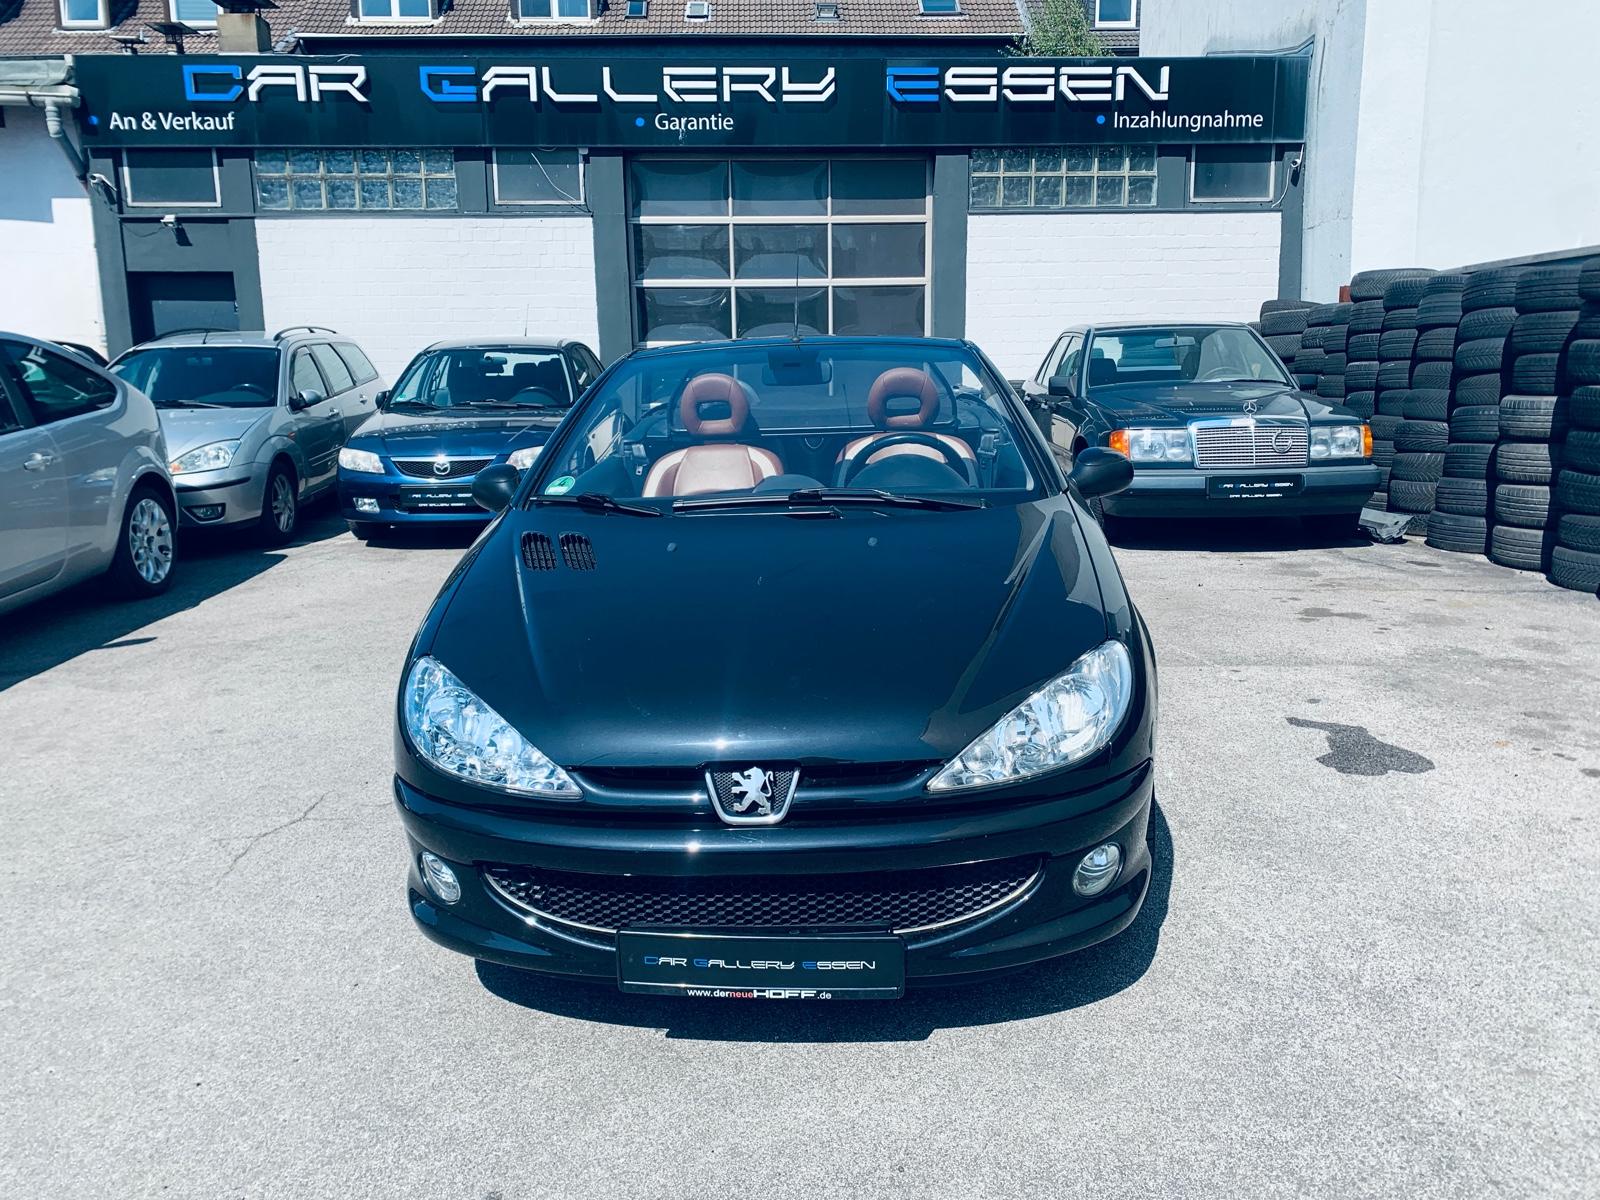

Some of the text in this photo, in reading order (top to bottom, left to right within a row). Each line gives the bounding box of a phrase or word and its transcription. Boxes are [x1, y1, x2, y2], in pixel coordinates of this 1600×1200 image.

[182, 64, 1170, 102] CAR GALLERY ESSEN
[109, 111, 235, 131] An & Verkauf
[654, 113, 735, 131] Garantie
[1113, 111, 1264, 132] Inzahlungnahme
[644, 956, 876, 970] CAR GALLERY ESSEN
[687, 988, 832, 1000] www.derneueHOFF.de
